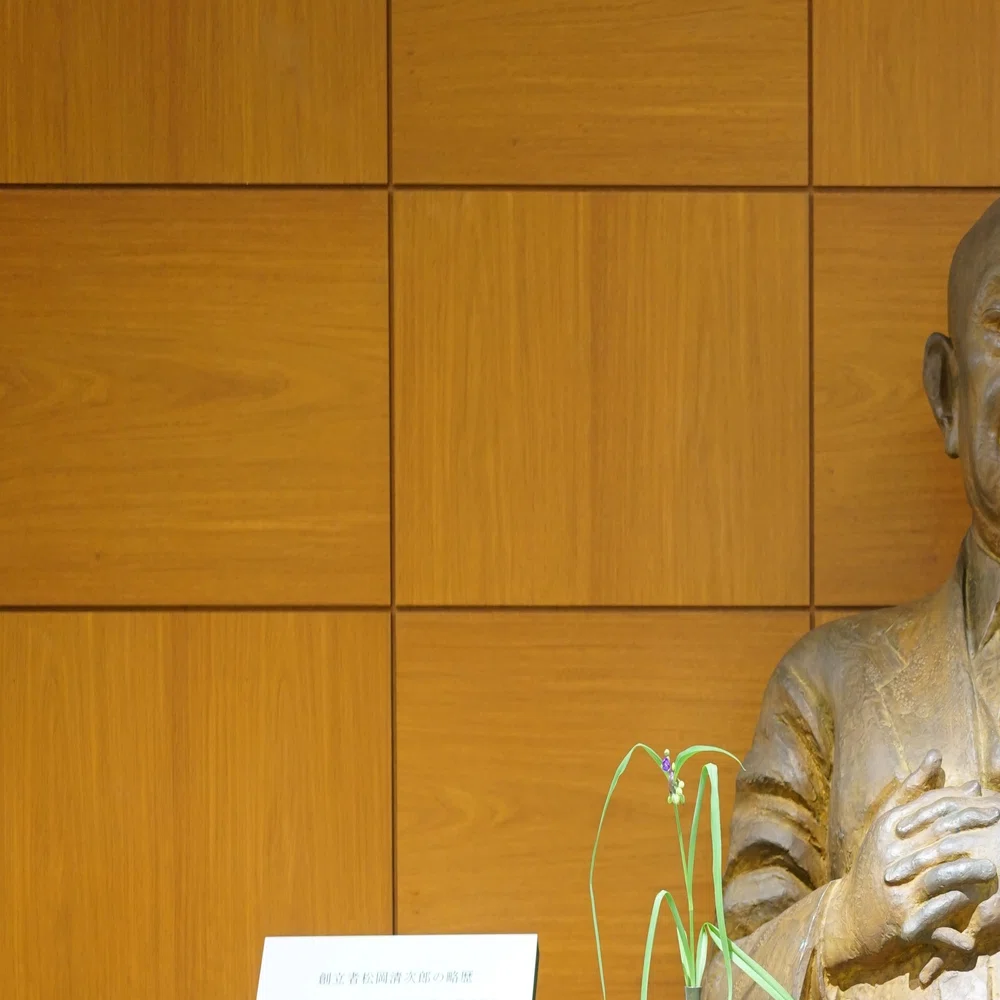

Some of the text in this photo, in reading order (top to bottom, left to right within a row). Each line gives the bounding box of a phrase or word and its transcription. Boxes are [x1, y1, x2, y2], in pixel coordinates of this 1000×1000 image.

[318, 969, 474, 986] 創立者松岡清次郎の略歴
